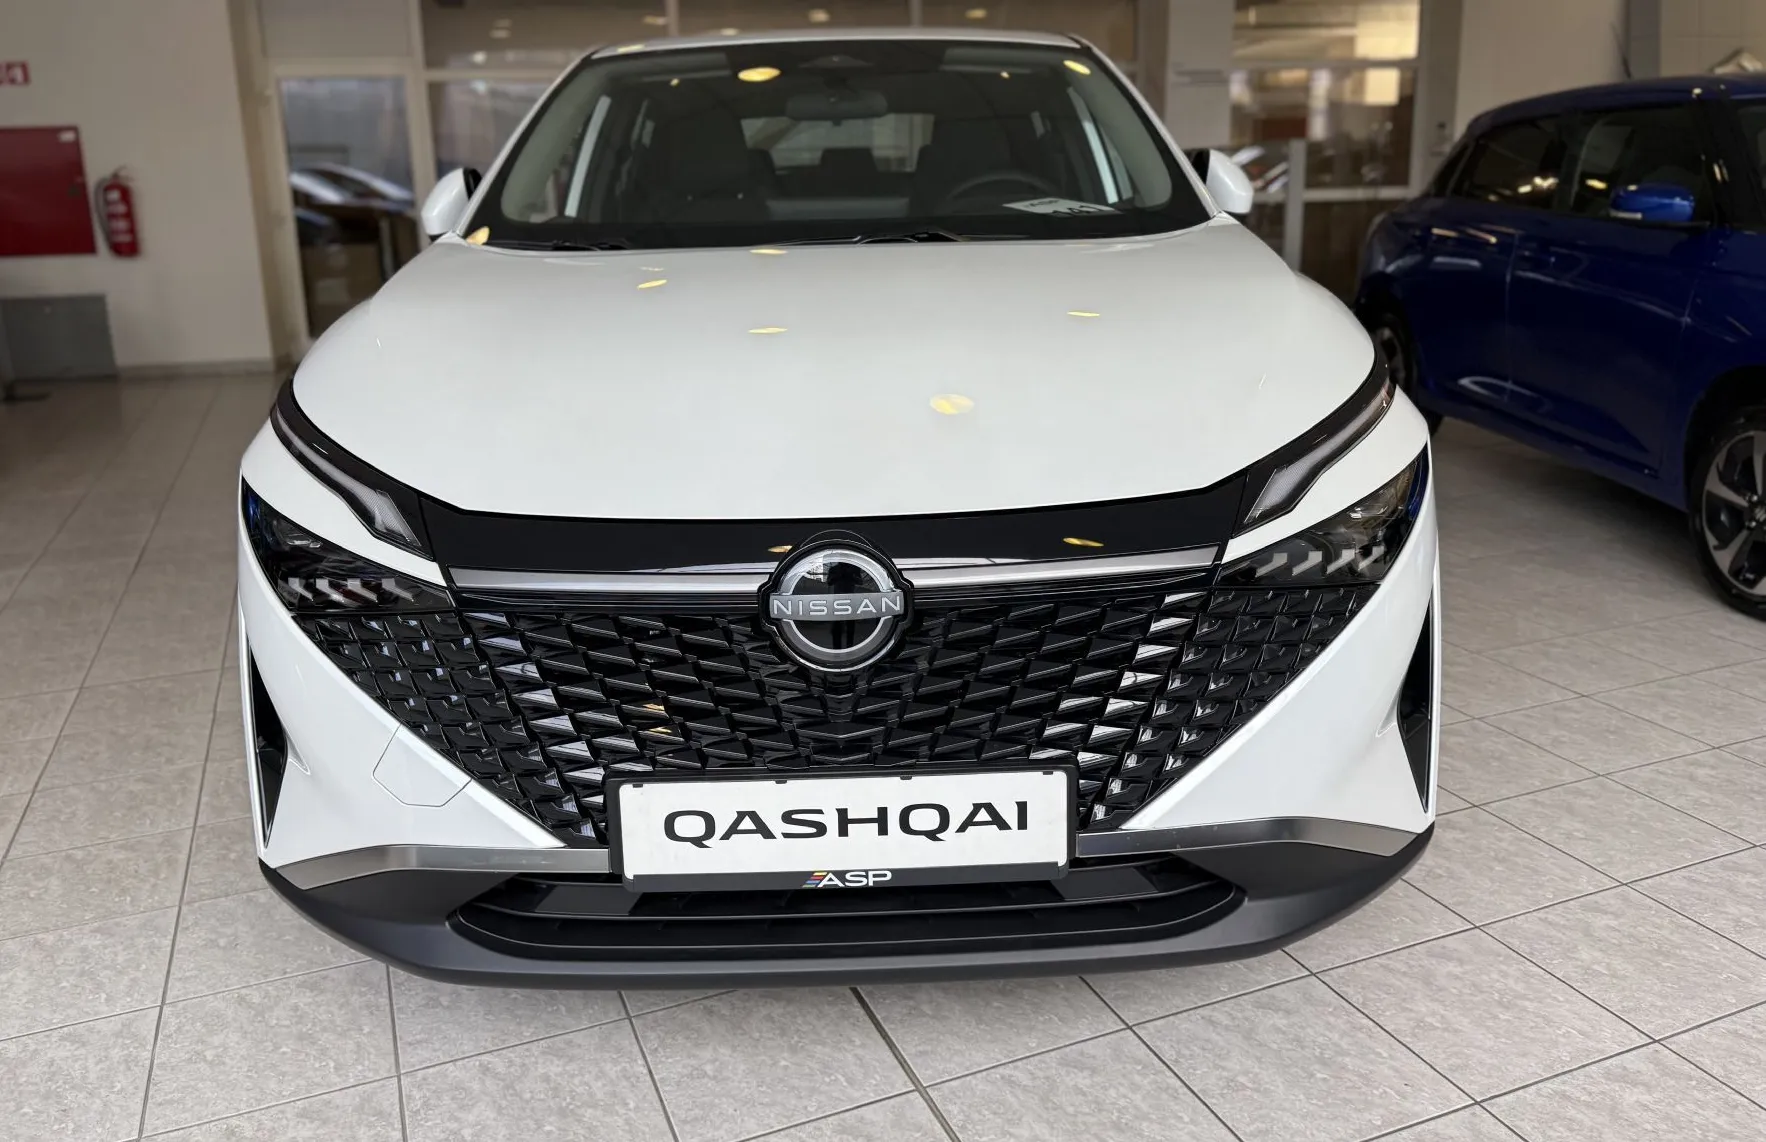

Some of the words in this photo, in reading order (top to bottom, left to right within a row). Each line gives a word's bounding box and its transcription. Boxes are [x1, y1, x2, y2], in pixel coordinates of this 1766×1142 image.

[773, 595, 900, 616] NISSAN
[663, 800, 1028, 849] QASHQAI
[816, 870, 893, 888] ASP
